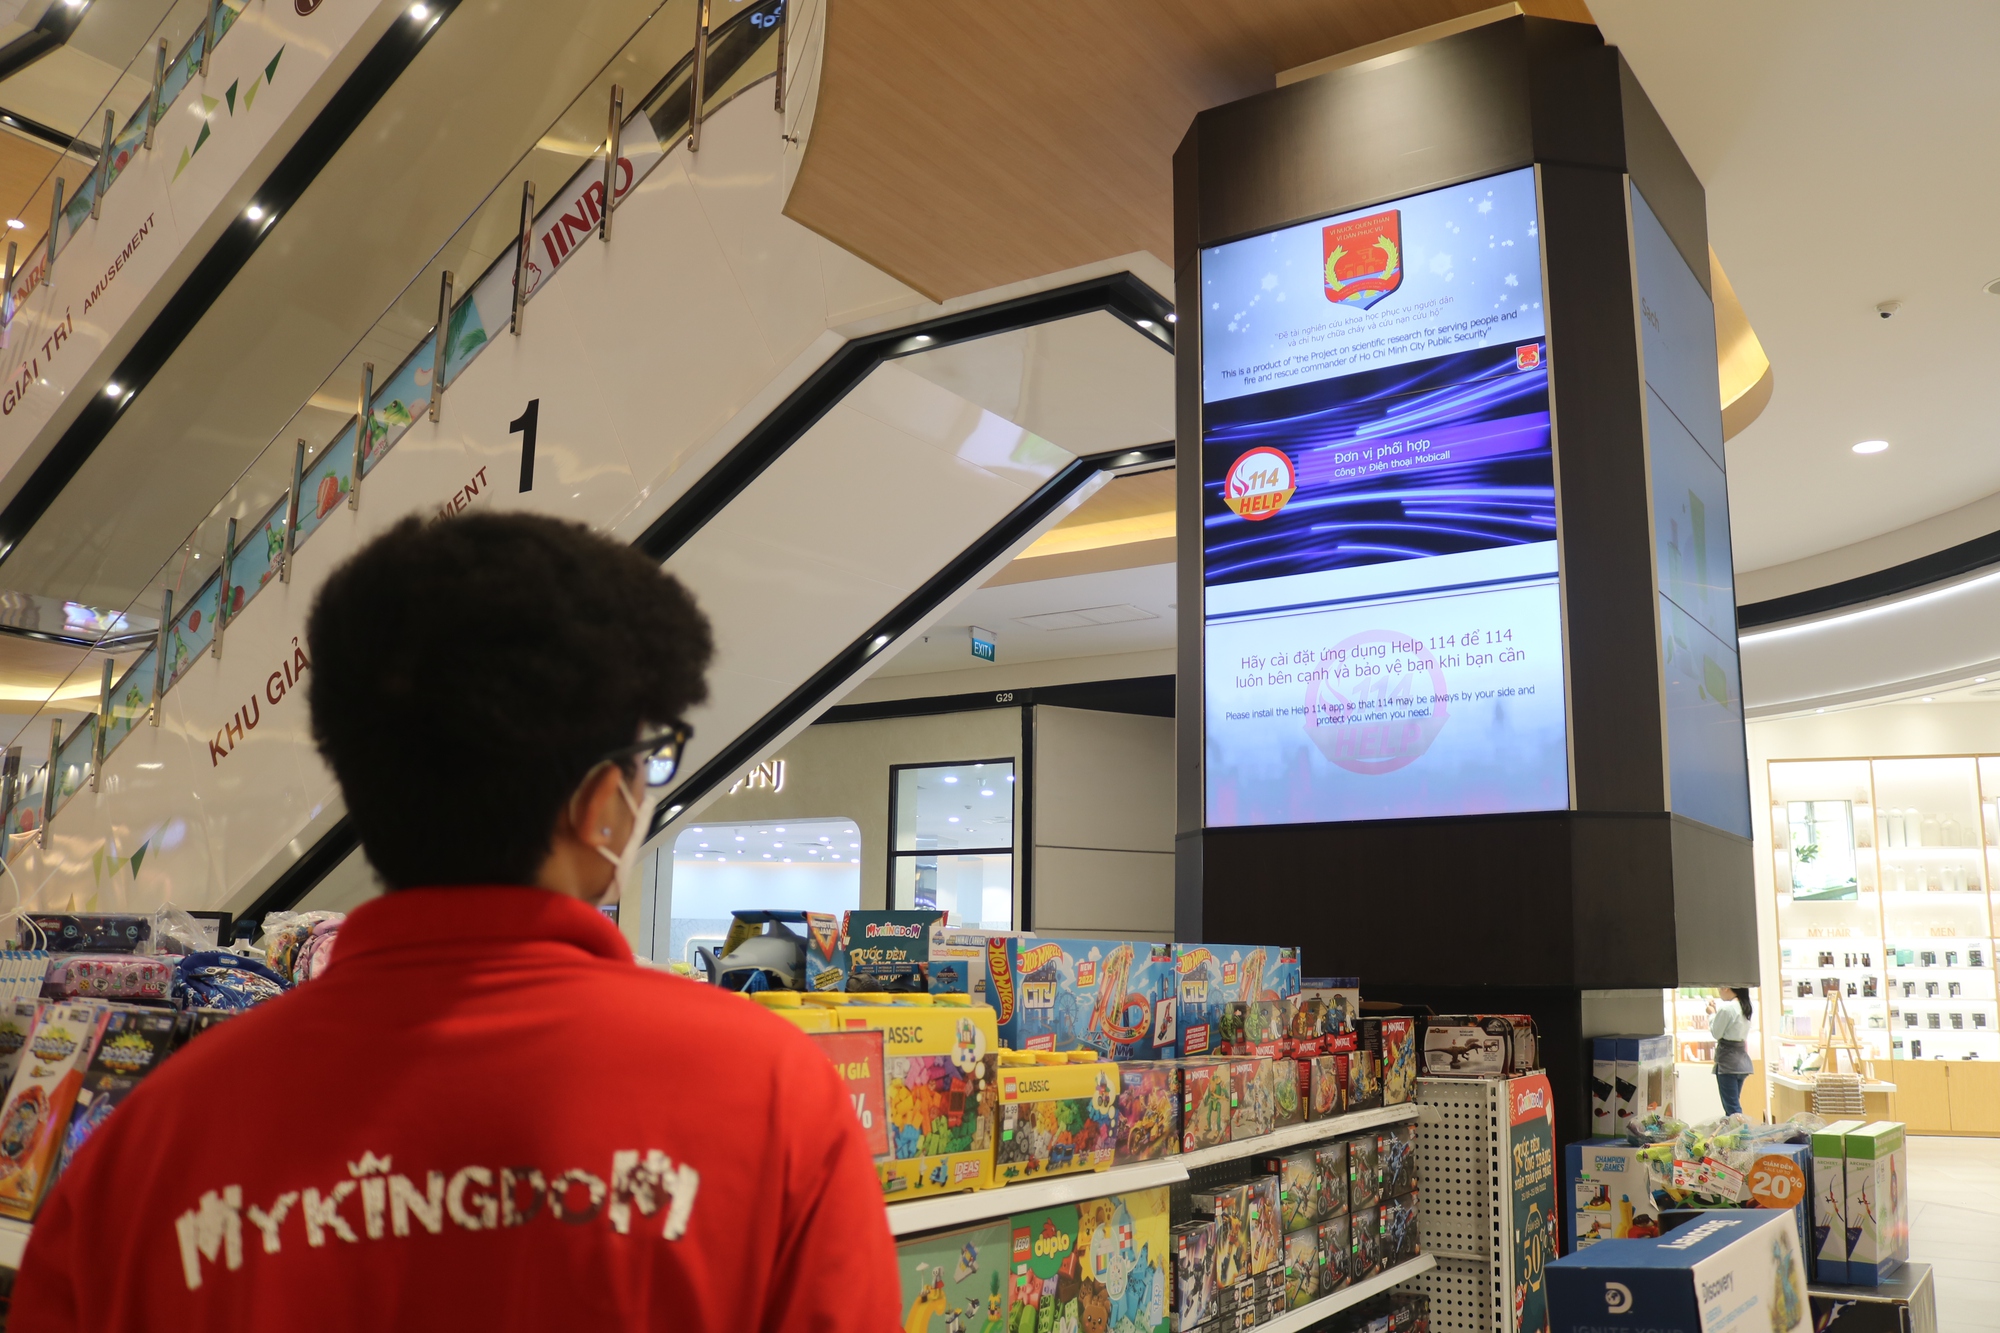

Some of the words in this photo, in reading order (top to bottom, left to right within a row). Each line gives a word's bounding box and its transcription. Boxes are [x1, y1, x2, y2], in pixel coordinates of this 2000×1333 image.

[2, 358, 39, 415] GIẢI
[41, 305, 73, 362] TRÍ
[83, 212, 154, 315] AMUSEMENT
[1221, 369, 1237, 379] This
[1238, 367, 1244, 376] is
[1253, 359, 1281, 374] product
[1283, 356, 1291, 366] of
[1311, 347, 1337, 360] Project
[1339, 346, 1349, 354] on
[1352, 338, 1385, 352] scientific
[1388, 330, 1422, 344] research
[1424, 327, 1436, 336] for
[1438, 321, 1467, 334] serving
[1470, 315, 1499, 329] people
[1501, 310, 1518, 321] and
[1244, 376, 1256, 385] fire
[1258, 372, 1272, 383] and
[1274, 367, 1299, 379] rescue
[1301, 357, 1347, 373] commander
[1349, 354, 1357, 364] of
[1360, 353, 1371, 362] Ho
[1373, 348, 1386, 358] Chi
[1388, 345, 1407, 356] Minh
[1409, 341, 1425, 351] City
[1428, 336, 1452, 348] Public
[509, 398, 539, 493] 1
[1334, 451, 1359, 464] Đơn
[1363, 447, 1373, 461] vị
[1377, 441, 1403, 459] phối
[1406, 439, 1431, 453] hợp
[1334, 467, 1356, 478] Công
[1358, 465, 1367, 475] ty
[1369, 461, 1389, 472] Điện
[1391, 457, 1412, 468] thoại
[1415, 450, 1451, 464] Mobicall
[1249, 468, 1279, 490] 114
[1240, 493, 1283, 514] HELP
[974, 641, 989, 656] EXIT
[1241, 655, 1266, 670] Hãy
[1270, 652, 1288, 667] cài
[1293, 649, 1315, 666] đặt
[1320, 647, 1346, 663] ứng
[1351, 645, 1386, 660] dụng
[1391, 639, 1424, 654] Help
[1430, 635, 1456, 650] 114
[1460, 629, 1480, 647] để
[1486, 628, 1513, 645] 114
[1236, 674, 1263, 689] luôn
[1268, 671, 1292, 686] bên
[1297, 667, 1329, 685] cạnh
[1334, 666, 1350, 679] và
[1355, 662, 1381, 677] bảo
[1385, 659, 1402, 676] vệ
[1407, 659, 1434, 674] bạn
[1439, 654, 1460, 669] khi
[1466, 652, 1493, 668] bạn
[1499, 647, 1526, 663] cần
[208, 694, 260, 768] KHU
[266, 636, 313, 705] GIẢ
[995, 692, 1014, 703] G29
[1225, 710, 1250, 721] Please
[1252, 707, 1274, 718] install
[1276, 706, 1289, 716] the
[1291, 705, 1309, 718] Help
[1312, 703, 1327, 714] 114
[1329, 703, 1345, 714] app
[1346, 702, 1356, 710] so
[1358, 699, 1375, 709] that
[1378, 698, 1393, 708] 114
[1395, 697, 1414, 707] may
[1416, 694, 1427, 704] be
[1430, 692, 1459, 703] always
[1461, 690, 1473, 701] by
[1474, 689, 1495, 700] your
[1497, 687, 1515, 697] side
[1518, 684, 1535, 695] and
[1316, 713, 1345, 727] protect
[1347, 712, 1362, 724] you
[1365, 711, 1387, 721] when
[1390, 709, 1406, 720] you
[1407, 706, 1432, 718] need.
[865, 922, 922, 939] MYKINGDOM
[1808, 928, 1824, 937] MY
[1827, 928, 1851, 937] HAIR
[1930, 927, 1956, 937] MEN
[955, 1160, 980, 1175] IDEAS
[1595, 1155, 1625, 1164] CHAMPION
[1603, 1163, 1625, 1172] GAMES
[1752, 1171, 1803, 1199] 20%
[175, 1149, 699, 1290] MYKINGDOM
[1013, 1235, 1030, 1253] LEGO
[1034, 1229, 1070, 1259] duplo
